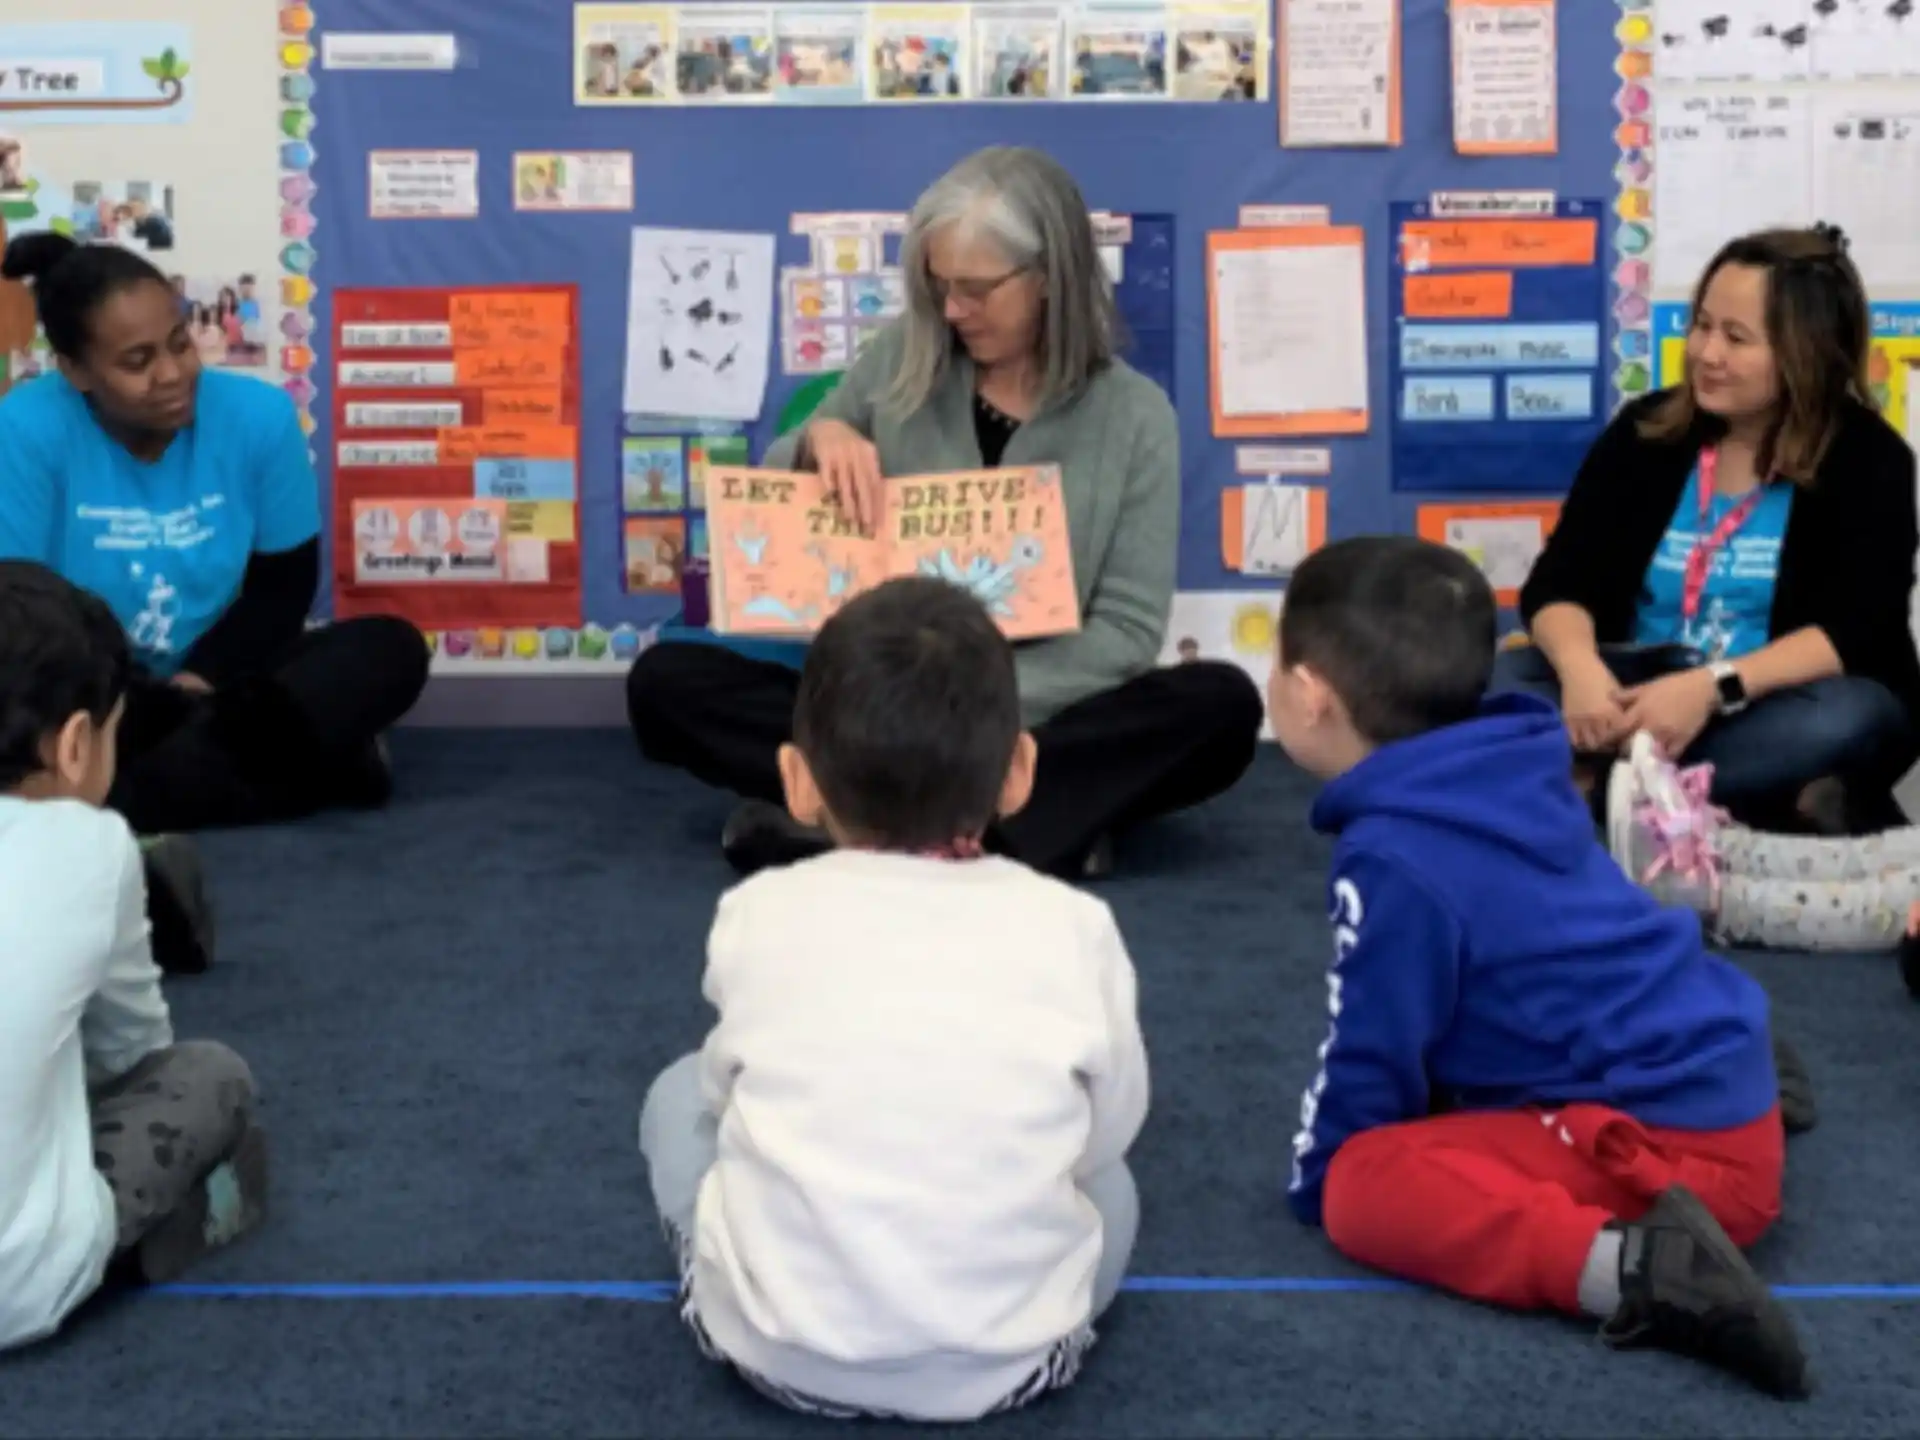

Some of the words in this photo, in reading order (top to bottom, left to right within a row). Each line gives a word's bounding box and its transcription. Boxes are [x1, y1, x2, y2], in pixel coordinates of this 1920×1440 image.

[15, 66, 79, 90] Tree
[721, 477, 796, 503] LET
[901, 478, 1026, 510] DRIVE
